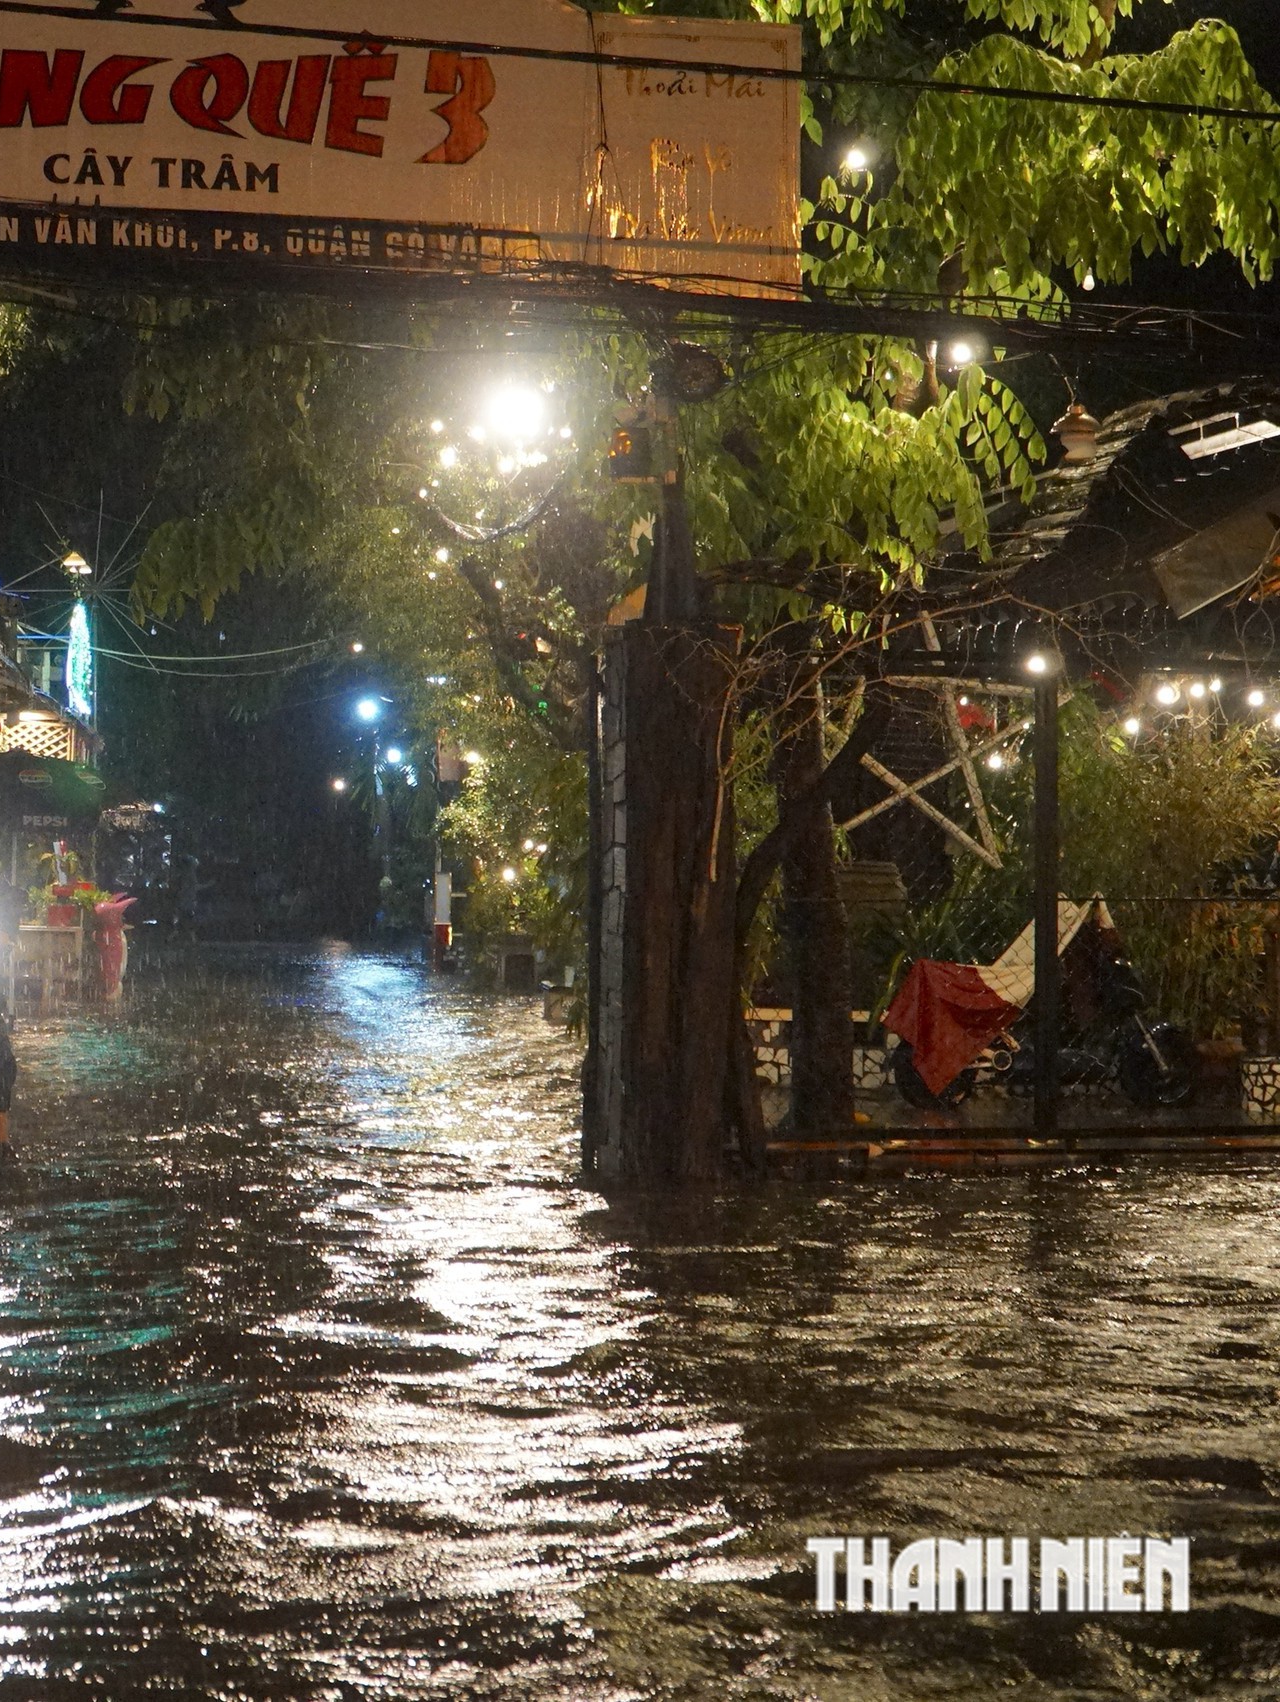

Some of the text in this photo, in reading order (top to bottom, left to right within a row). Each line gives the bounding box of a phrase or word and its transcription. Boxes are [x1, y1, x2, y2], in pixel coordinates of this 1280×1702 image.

[170, 29, 398, 158] QUÊ
[414, 50, 496, 165] 3
[43, 147, 281, 193] CÂY TRÂM
[33, 212, 97, 245] VĂN
[286, 224, 371, 262] QUẬN
[22, 814, 68, 828] PEPSI
